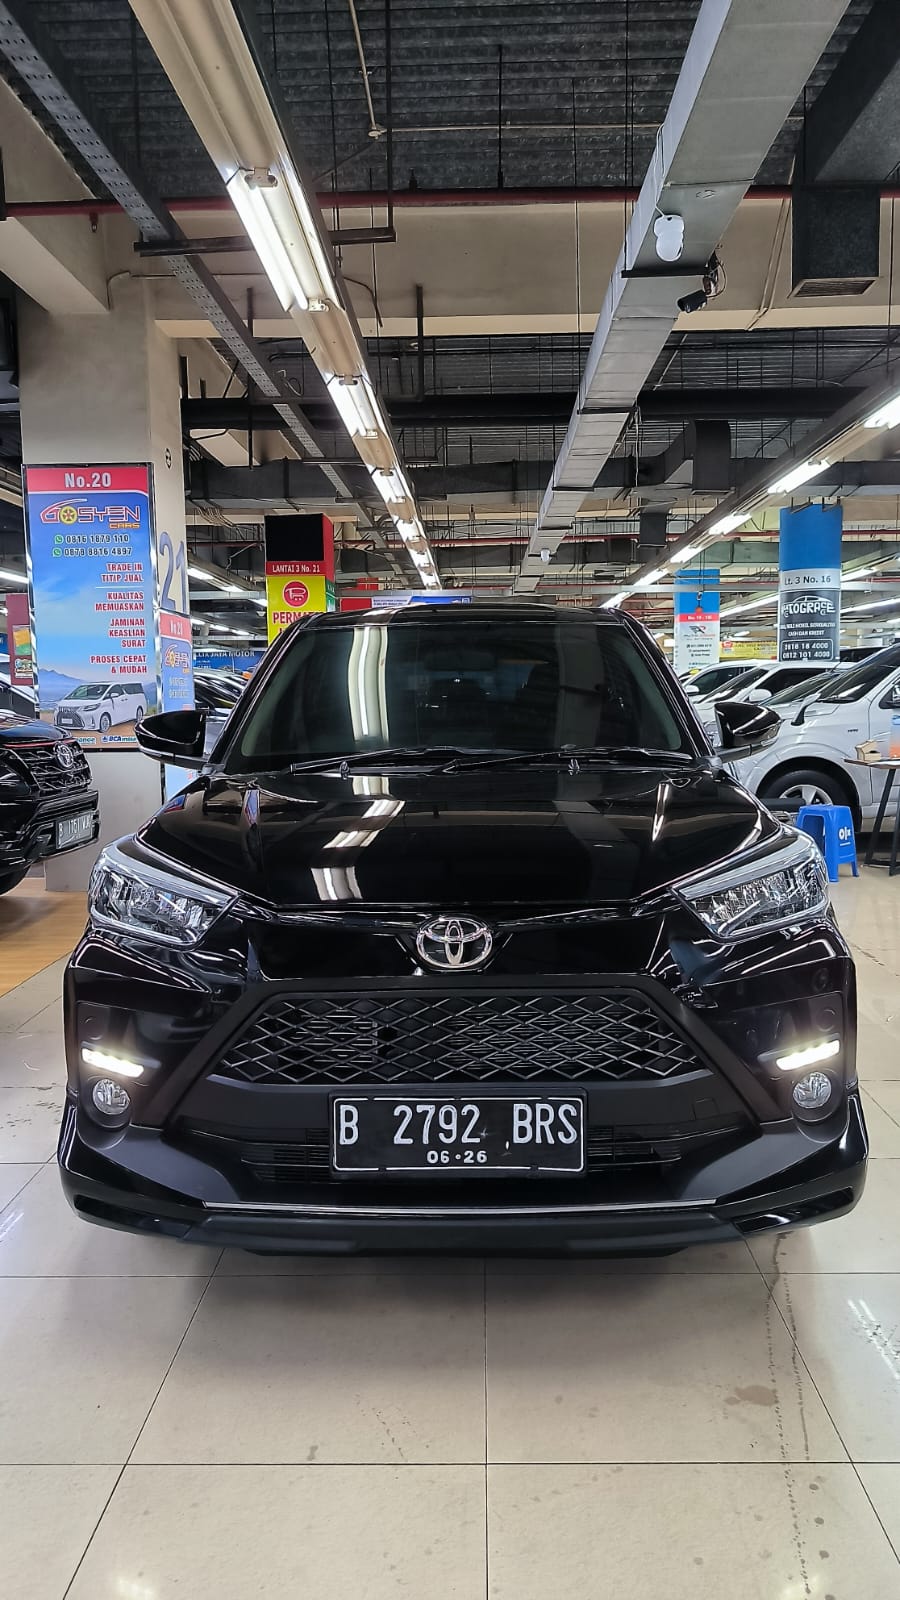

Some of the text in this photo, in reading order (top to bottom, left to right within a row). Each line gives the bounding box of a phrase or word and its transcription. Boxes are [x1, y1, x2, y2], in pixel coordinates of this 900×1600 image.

[64, 472, 112, 488] No.20
[40, 498, 140, 525] GOSYEN
[114, 533, 129, 542] 110
[107, 563, 143, 571] TRADE IN
[272, 565, 295, 573] LANTAI
[159, 531, 189, 613] 21
[102, 574, 143, 583] TITIP JUAL
[795, 576, 801, 584] 3
[803, 575, 818, 584] No.
[107, 592, 144, 600] KUALITAS
[95, 603, 144, 611] MEMUASKAN
[110, 619, 145, 627] JAMINAN
[109, 630, 145, 638] KEASLIAN
[121, 640, 146, 648] SURAT
[90, 655, 147, 663] PROSES CEPAT
[119, 666, 147, 674] MUDAH
[340, 1103, 578, 1145] B 2792 BRS
